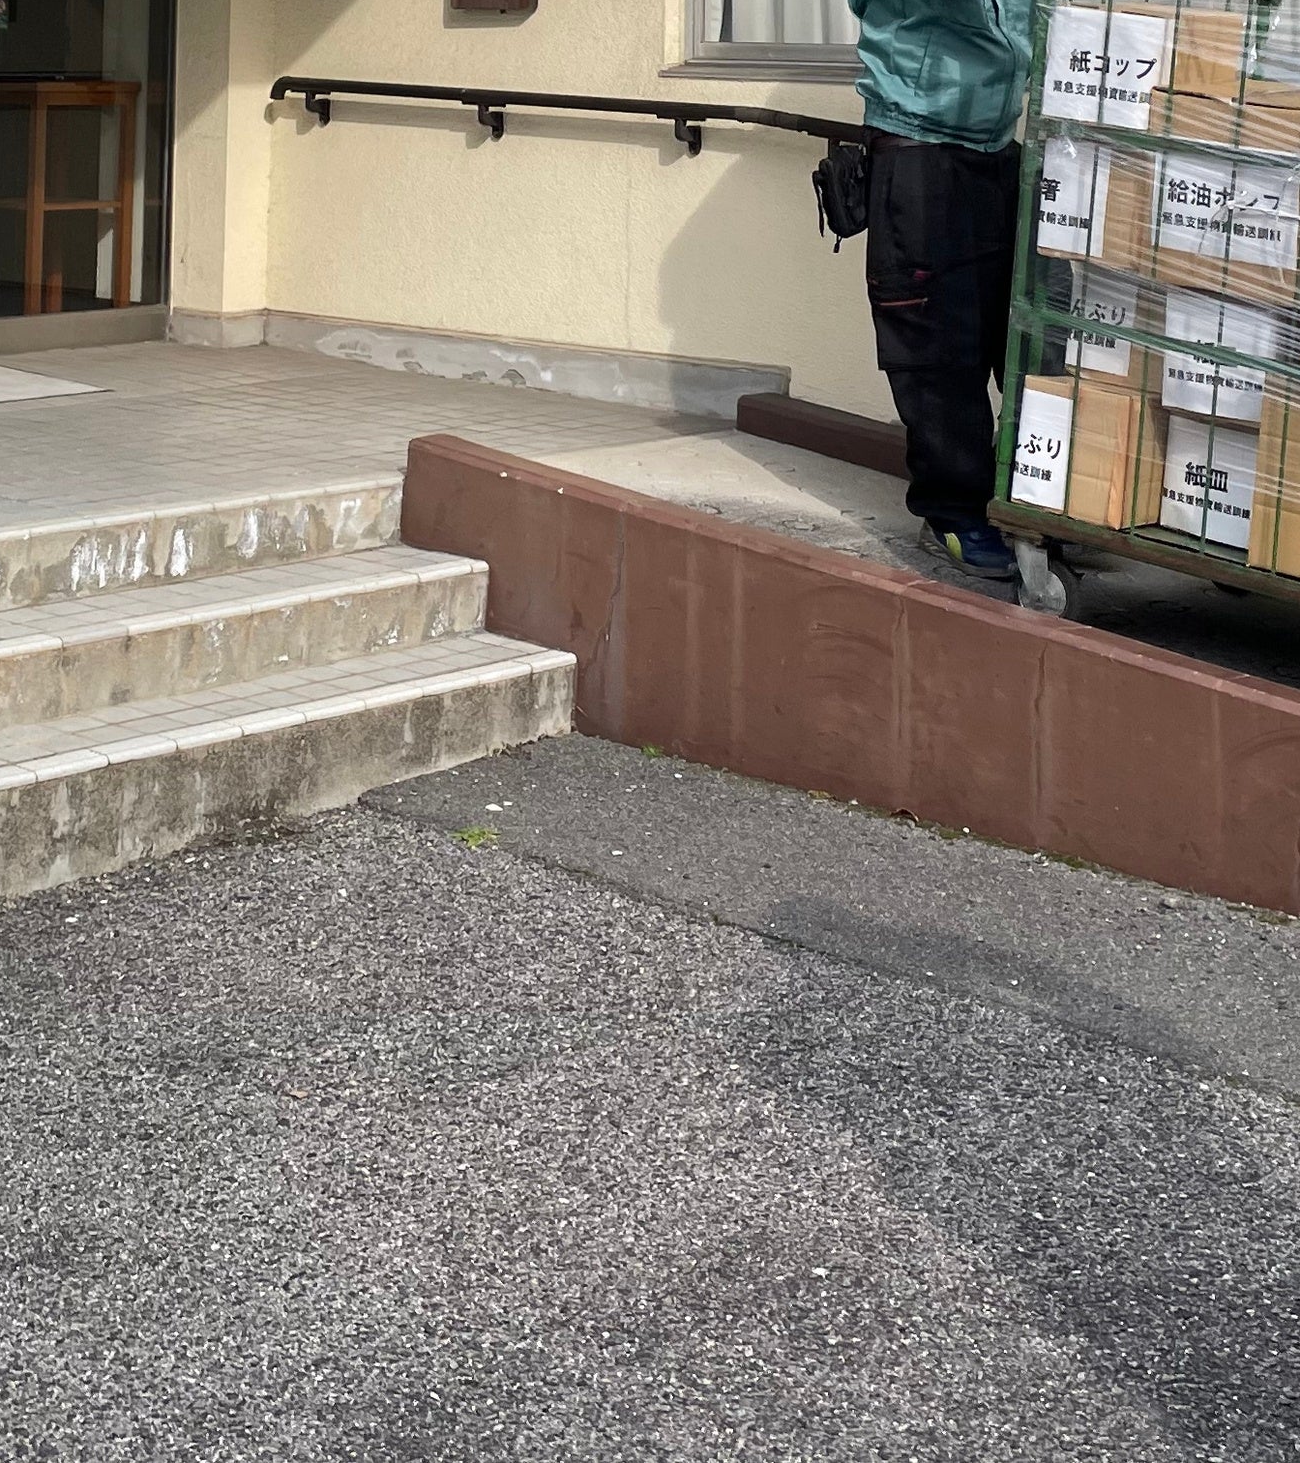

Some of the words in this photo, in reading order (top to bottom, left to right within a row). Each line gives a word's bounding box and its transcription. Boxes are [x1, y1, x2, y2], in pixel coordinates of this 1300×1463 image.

[1069, 48, 1158, 80] 紙コップ
[1184, 460, 1229, 494] 紙皿
